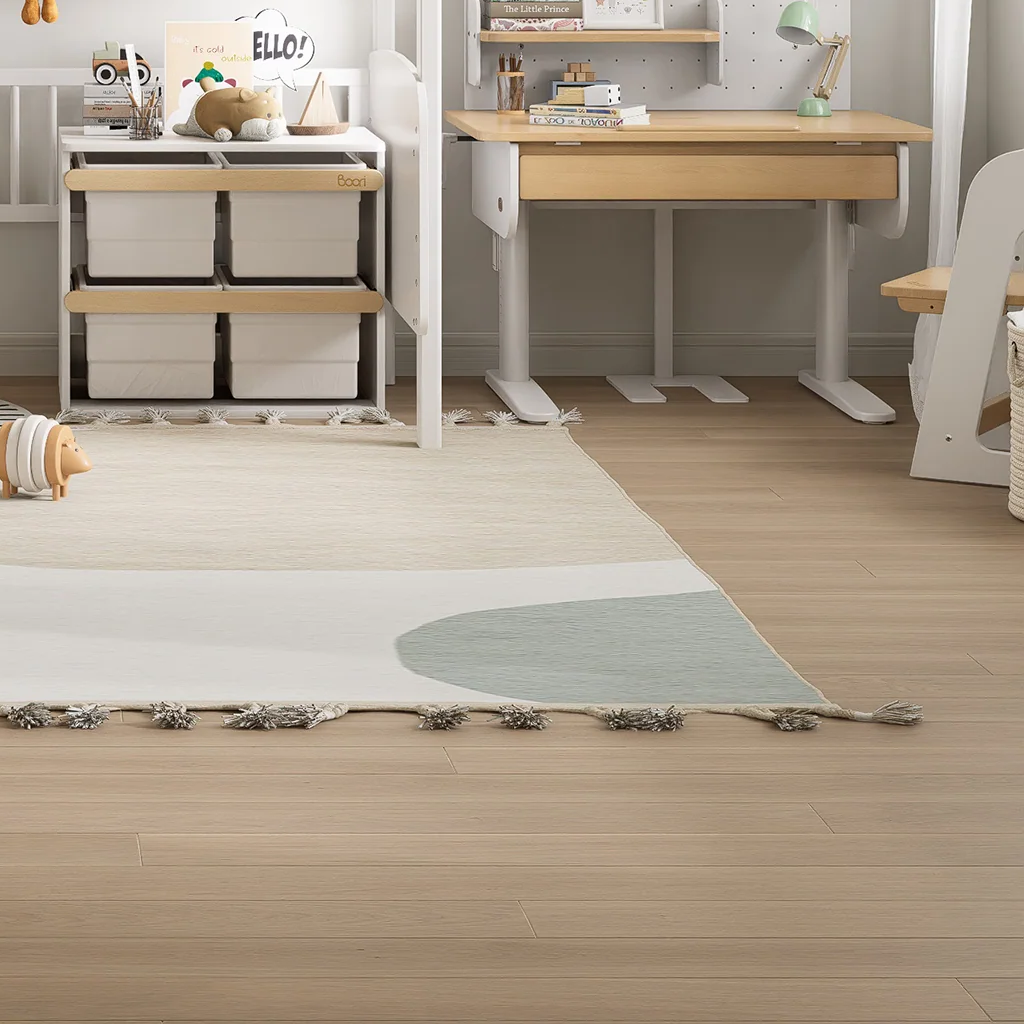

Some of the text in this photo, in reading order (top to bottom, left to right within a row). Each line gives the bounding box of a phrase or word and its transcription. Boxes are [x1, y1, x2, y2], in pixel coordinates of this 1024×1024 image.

[504, 5, 570, 13] The Little Prince
[206, 45, 225, 54] cold
[253, 31, 308, 61] ELLO!
[220, 54, 253, 63] outside
